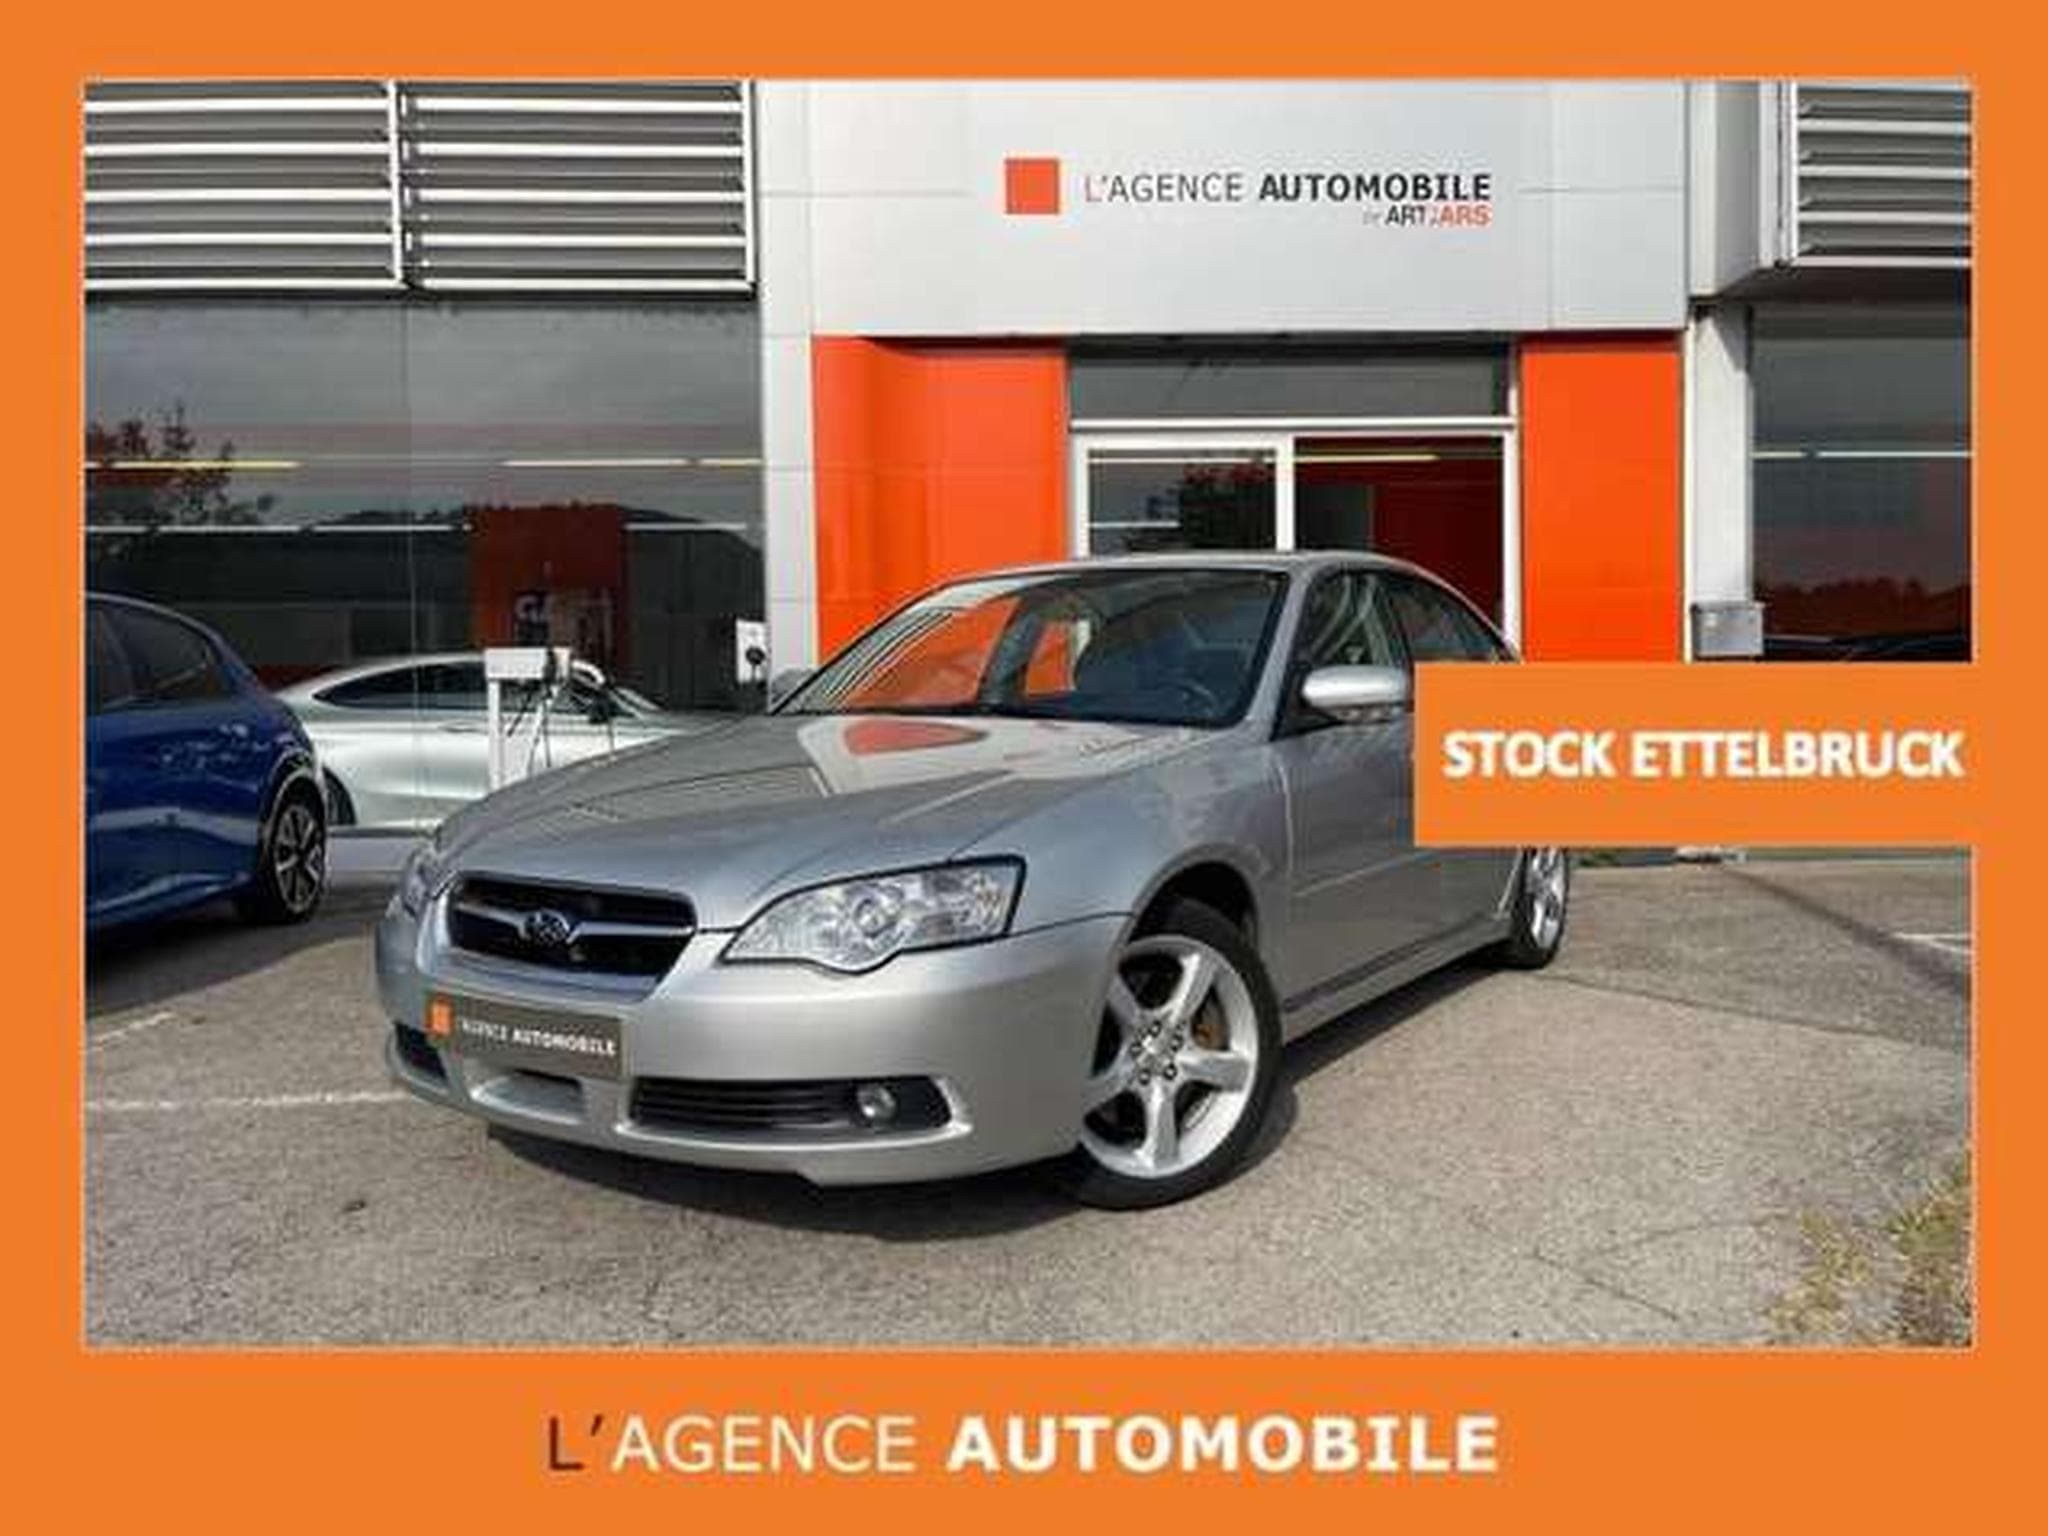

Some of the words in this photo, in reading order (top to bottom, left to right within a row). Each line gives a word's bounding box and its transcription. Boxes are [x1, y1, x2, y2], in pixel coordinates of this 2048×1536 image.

[1084, 173, 1243, 203] L'AGENCE
[1258, 172, 1492, 202] AUTOMOBILE
[511, 1027, 616, 1056] AUTOMOBILE
